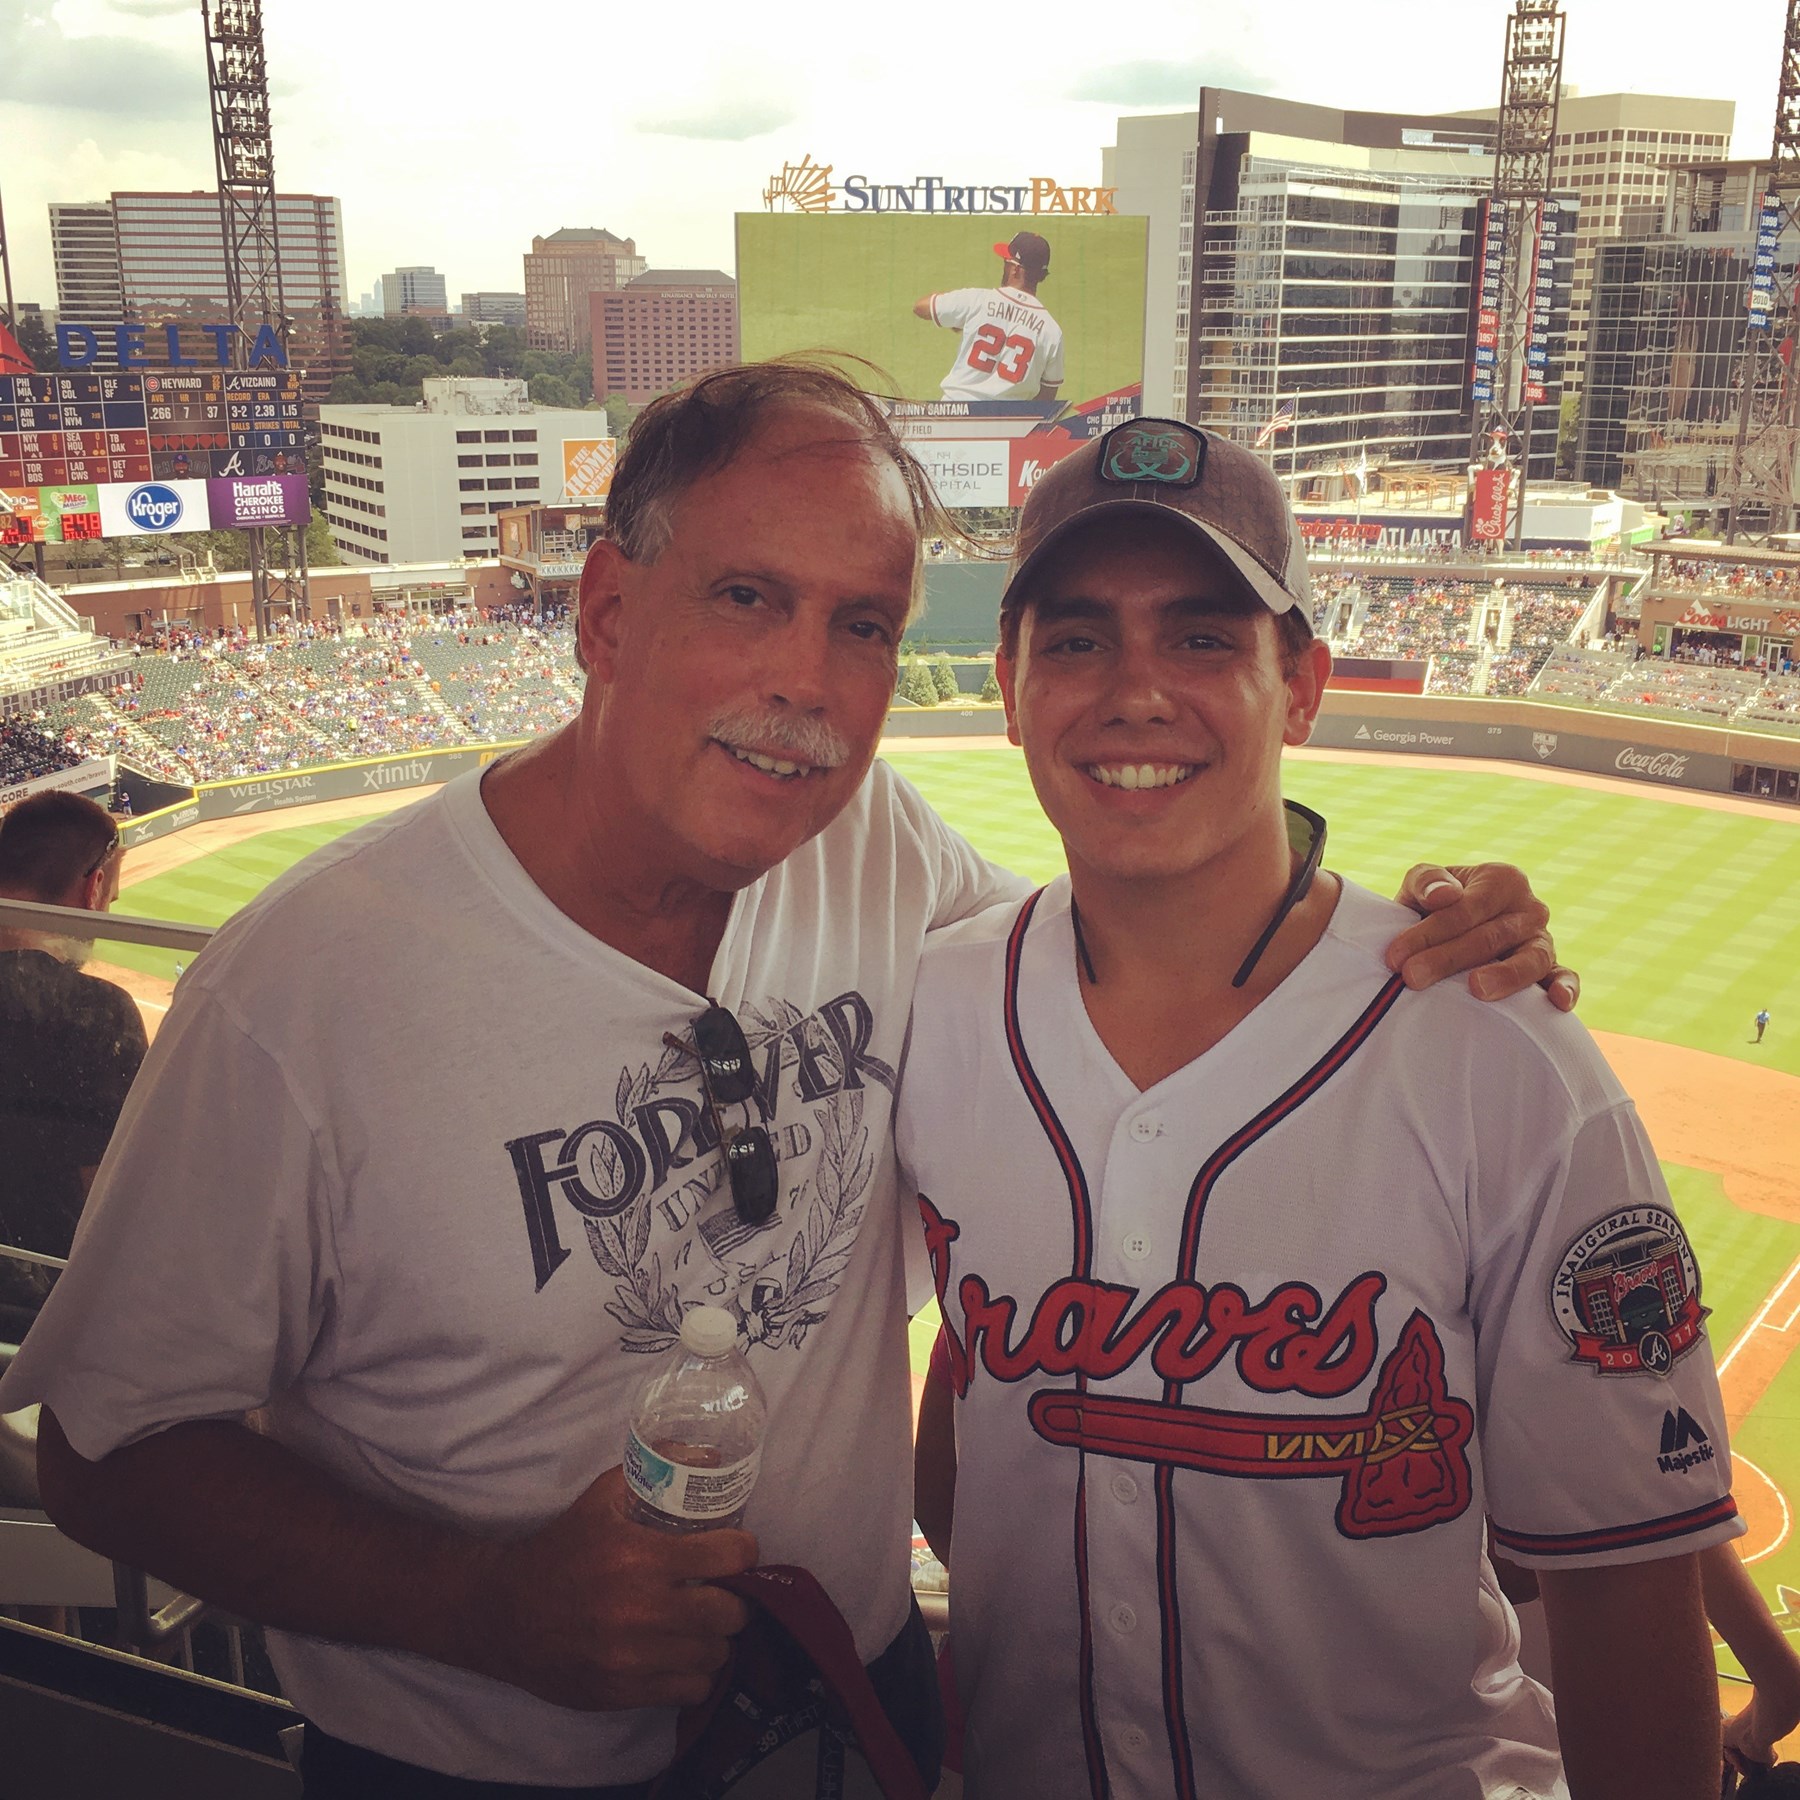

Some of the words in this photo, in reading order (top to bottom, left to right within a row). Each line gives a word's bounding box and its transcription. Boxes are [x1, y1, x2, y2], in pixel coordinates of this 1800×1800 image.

[1764, 196, 1780, 207] 1996
[1490, 202, 1504, 213] 1872
[1544, 202, 1558, 212] 1873
[1489, 221, 1503, 231] 1874
[1542, 221, 1557, 231] 1875
[1762, 216, 1777, 226] 1998
[1487, 240, 1501, 250] 1877
[1760, 236, 1776, 246] 2000
[1539, 259, 1553, 269] 1891
[1757, 256, 1773, 266] 2002
[1484, 278, 1499, 288] 1892
[1755, 275, 1771, 286] 2004
[1482, 297, 1497, 306] 1897
[1753, 294, 1768, 305] 2010
[987, 301, 1045, 336] SANTANA
[1481, 315, 1495, 325] 1914
[1534, 315, 1549, 325] 1948
[1751, 314, 1765, 325] 2013
[1479, 333, 1493, 343] 1957
[1532, 333, 1547, 344] 1958
[55, 323, 287, 368] DELTA
[967, 323, 1036, 384] 23
[1476, 369, 1490, 379] 1991
[1529, 370, 1543, 380] 1992
[16, 378, 30, 387] PHI
[61, 380, 71, 389] SD
[104, 379, 118, 388] CLE
[162, 378, 202, 389] HEYWARD
[240, 377, 277, 388] VIZCAINO
[17, 387, 32, 396] MIA
[62, 390, 77, 399] COL
[105, 389, 114, 398] SF
[227, 393, 250, 401] RECORD
[258, 392, 270, 400] ERA
[281, 392, 297, 400] WHIP
[20, 408, 33, 417] ARI
[64, 407, 78, 416] STL
[150, 406, 171, 420] .266
[184, 407, 190, 419] 7
[207, 406, 218, 418] 37
[232, 406, 247, 417] 3-2
[255, 405, 275, 417] 2.38
[282, 404, 298, 416] 1.15
[895, 404, 926, 416] DANNY
[928, 403, 969, 416] SANTANA
[21, 418, 35, 427] CIN
[66, 417, 82, 426] NYM
[254, 422, 279, 430] STRIKES
[282, 421, 300, 429] TOTAL
[1087, 416, 1099, 425] CHC
[912, 425, 932, 435] FIELD
[1088, 428, 1099, 436] ATL
[23, 434, 37, 442] NYY
[66, 433, 80, 441] SEA
[110, 434, 119, 443] TB
[238, 435, 245, 446] 0
[264, 434, 270, 446] 0
[289, 433, 295, 445] 0
[24, 443, 39, 452] MIN
[67, 442, 83, 451] HOU
[111, 443, 126, 452] OAK
[569, 445, 590, 470] THE
[26, 464, 42, 472] TOR
[70, 462, 84, 471] LAD
[113, 460, 126, 469] DET
[566, 440, 616, 496] HOME
[28, 473, 43, 482] BOS
[71, 471, 88, 480] CWS
[114, 470, 124, 479] KC
[586, 461, 615, 496] DEPOT
[233, 480, 282, 497] Harrah's
[234, 496, 283, 506] CHEROKEE
[132, 492, 178, 526] Kroger
[235, 505, 284, 515] CASINOS
[63, 513, 100, 532] 248
[65, 531, 101, 539] MILLION
[1376, 527, 1461, 551] ATLANTA
[1679, 607, 1727, 628] Coors
[1727, 616, 1770, 632] LIGHT
[1487, 727, 1502, 735] 375
[1373, 730, 1416, 744] Georgia
[1419, 733, 1454, 745] Power
[1533, 733, 1556, 745] MLB
[1615, 747, 1690, 779] Coca-Cola
[363, 759, 432, 790] xfinity
[200, 789, 214, 798] 375
[274, 796, 294, 806] Health
[294, 794, 316, 805] System
[1556, 1211, 1640, 1297] INAUGURAL
[1646, 1210, 1690, 1259] SEASON
[1613, 1260, 1658, 1302] Braves
[1606, 1352, 1633, 1366] 20
[1676, 1326, 1693, 1344] 17
[1656, 1444, 1714, 1474] Majestic
